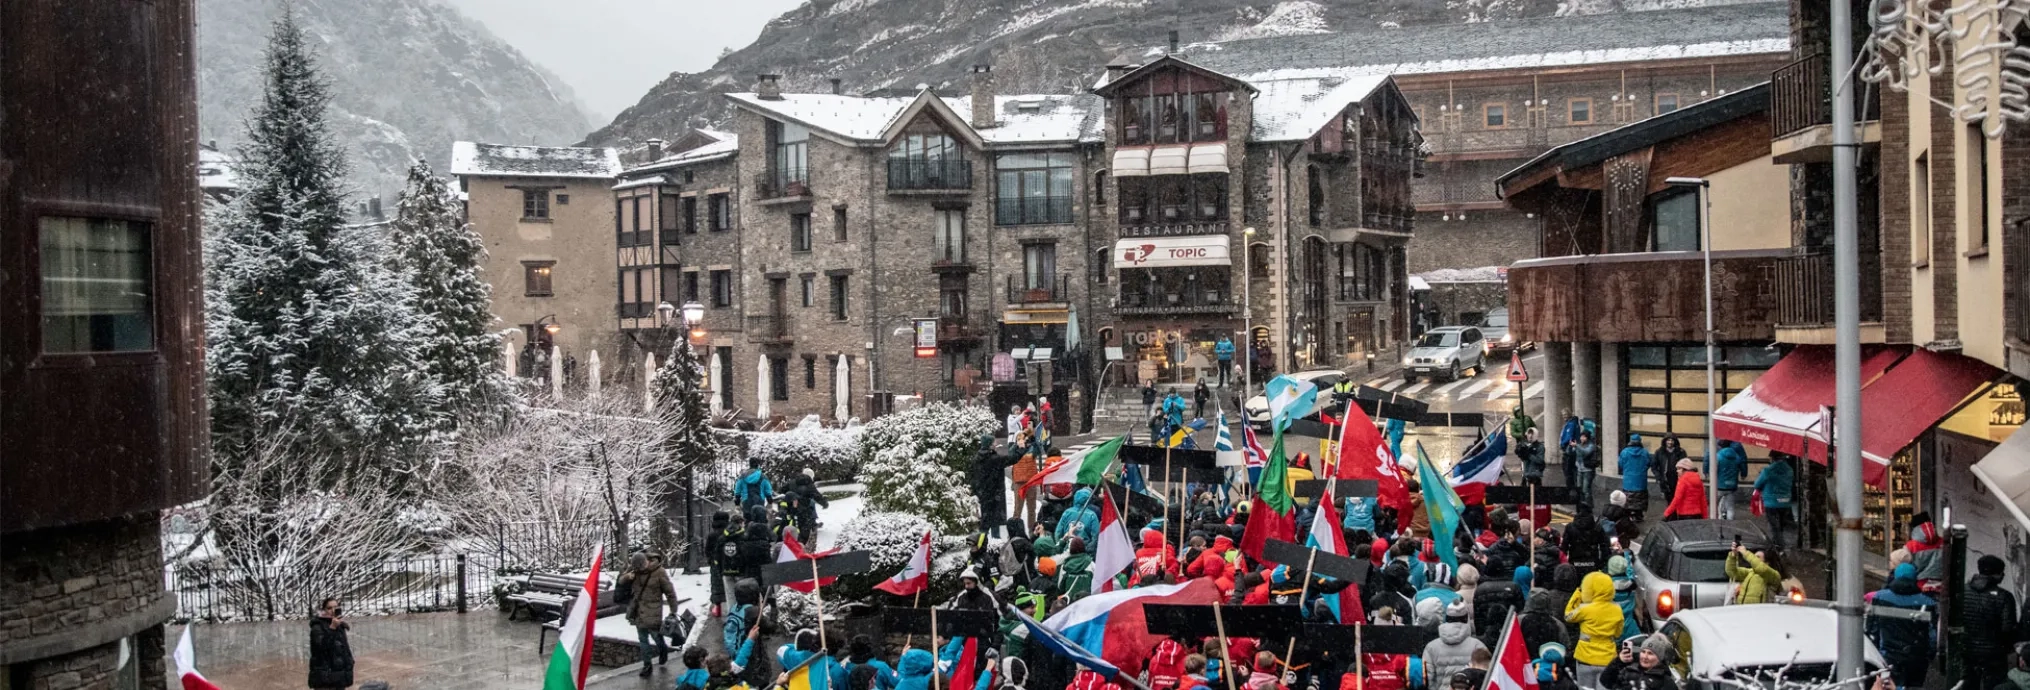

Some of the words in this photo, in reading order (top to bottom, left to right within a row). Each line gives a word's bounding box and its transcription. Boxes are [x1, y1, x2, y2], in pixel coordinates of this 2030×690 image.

[1121, 223, 1226, 236] RESTAURANT
[1169, 248, 1206, 258] TOPIC
[1125, 331, 1177, 345] TOPIC
